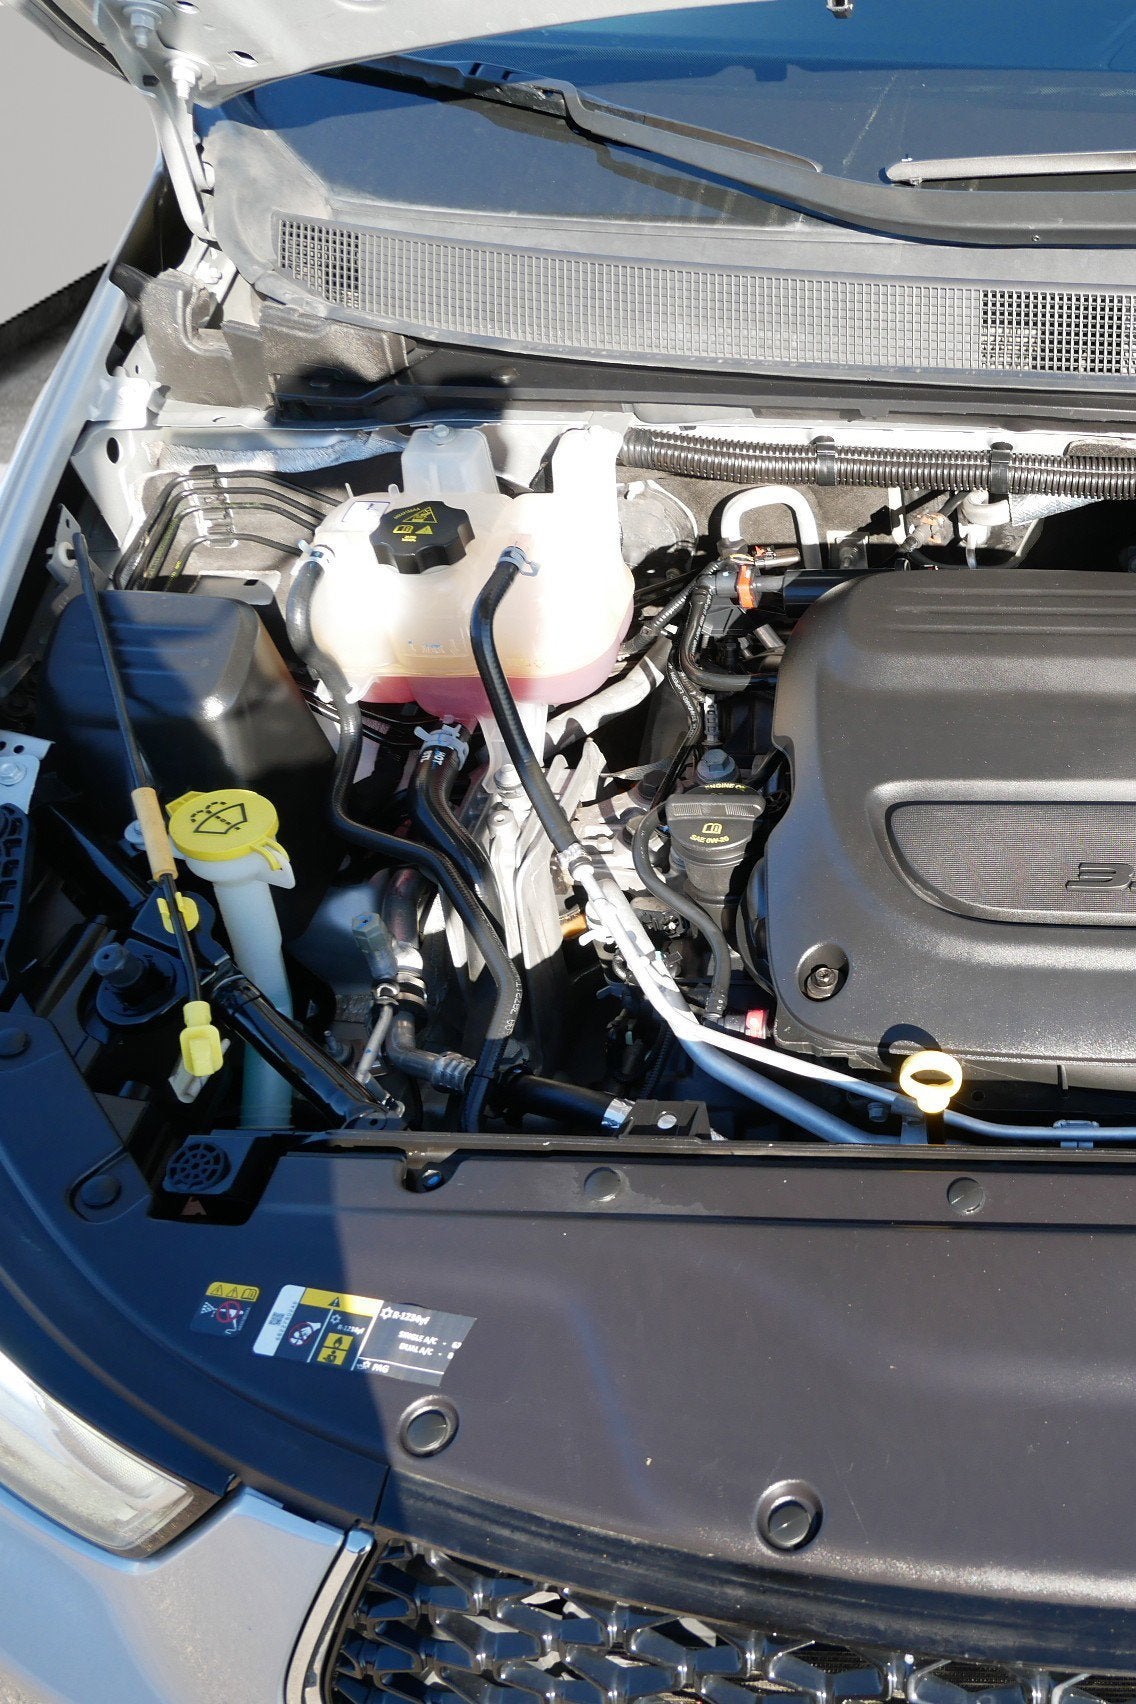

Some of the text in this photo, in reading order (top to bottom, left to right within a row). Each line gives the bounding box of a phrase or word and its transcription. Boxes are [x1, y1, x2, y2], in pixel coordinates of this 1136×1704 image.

[690, 834, 730, 844] SAE 0W-20
[397, 1330, 424, 1343] SINGLE
[423, 1335, 439, 1346] A/C
[398, 1342, 419, 1352] DUAL
[418, 1347, 434, 1356] A/C
[371, 1363, 390, 1374] PAG
